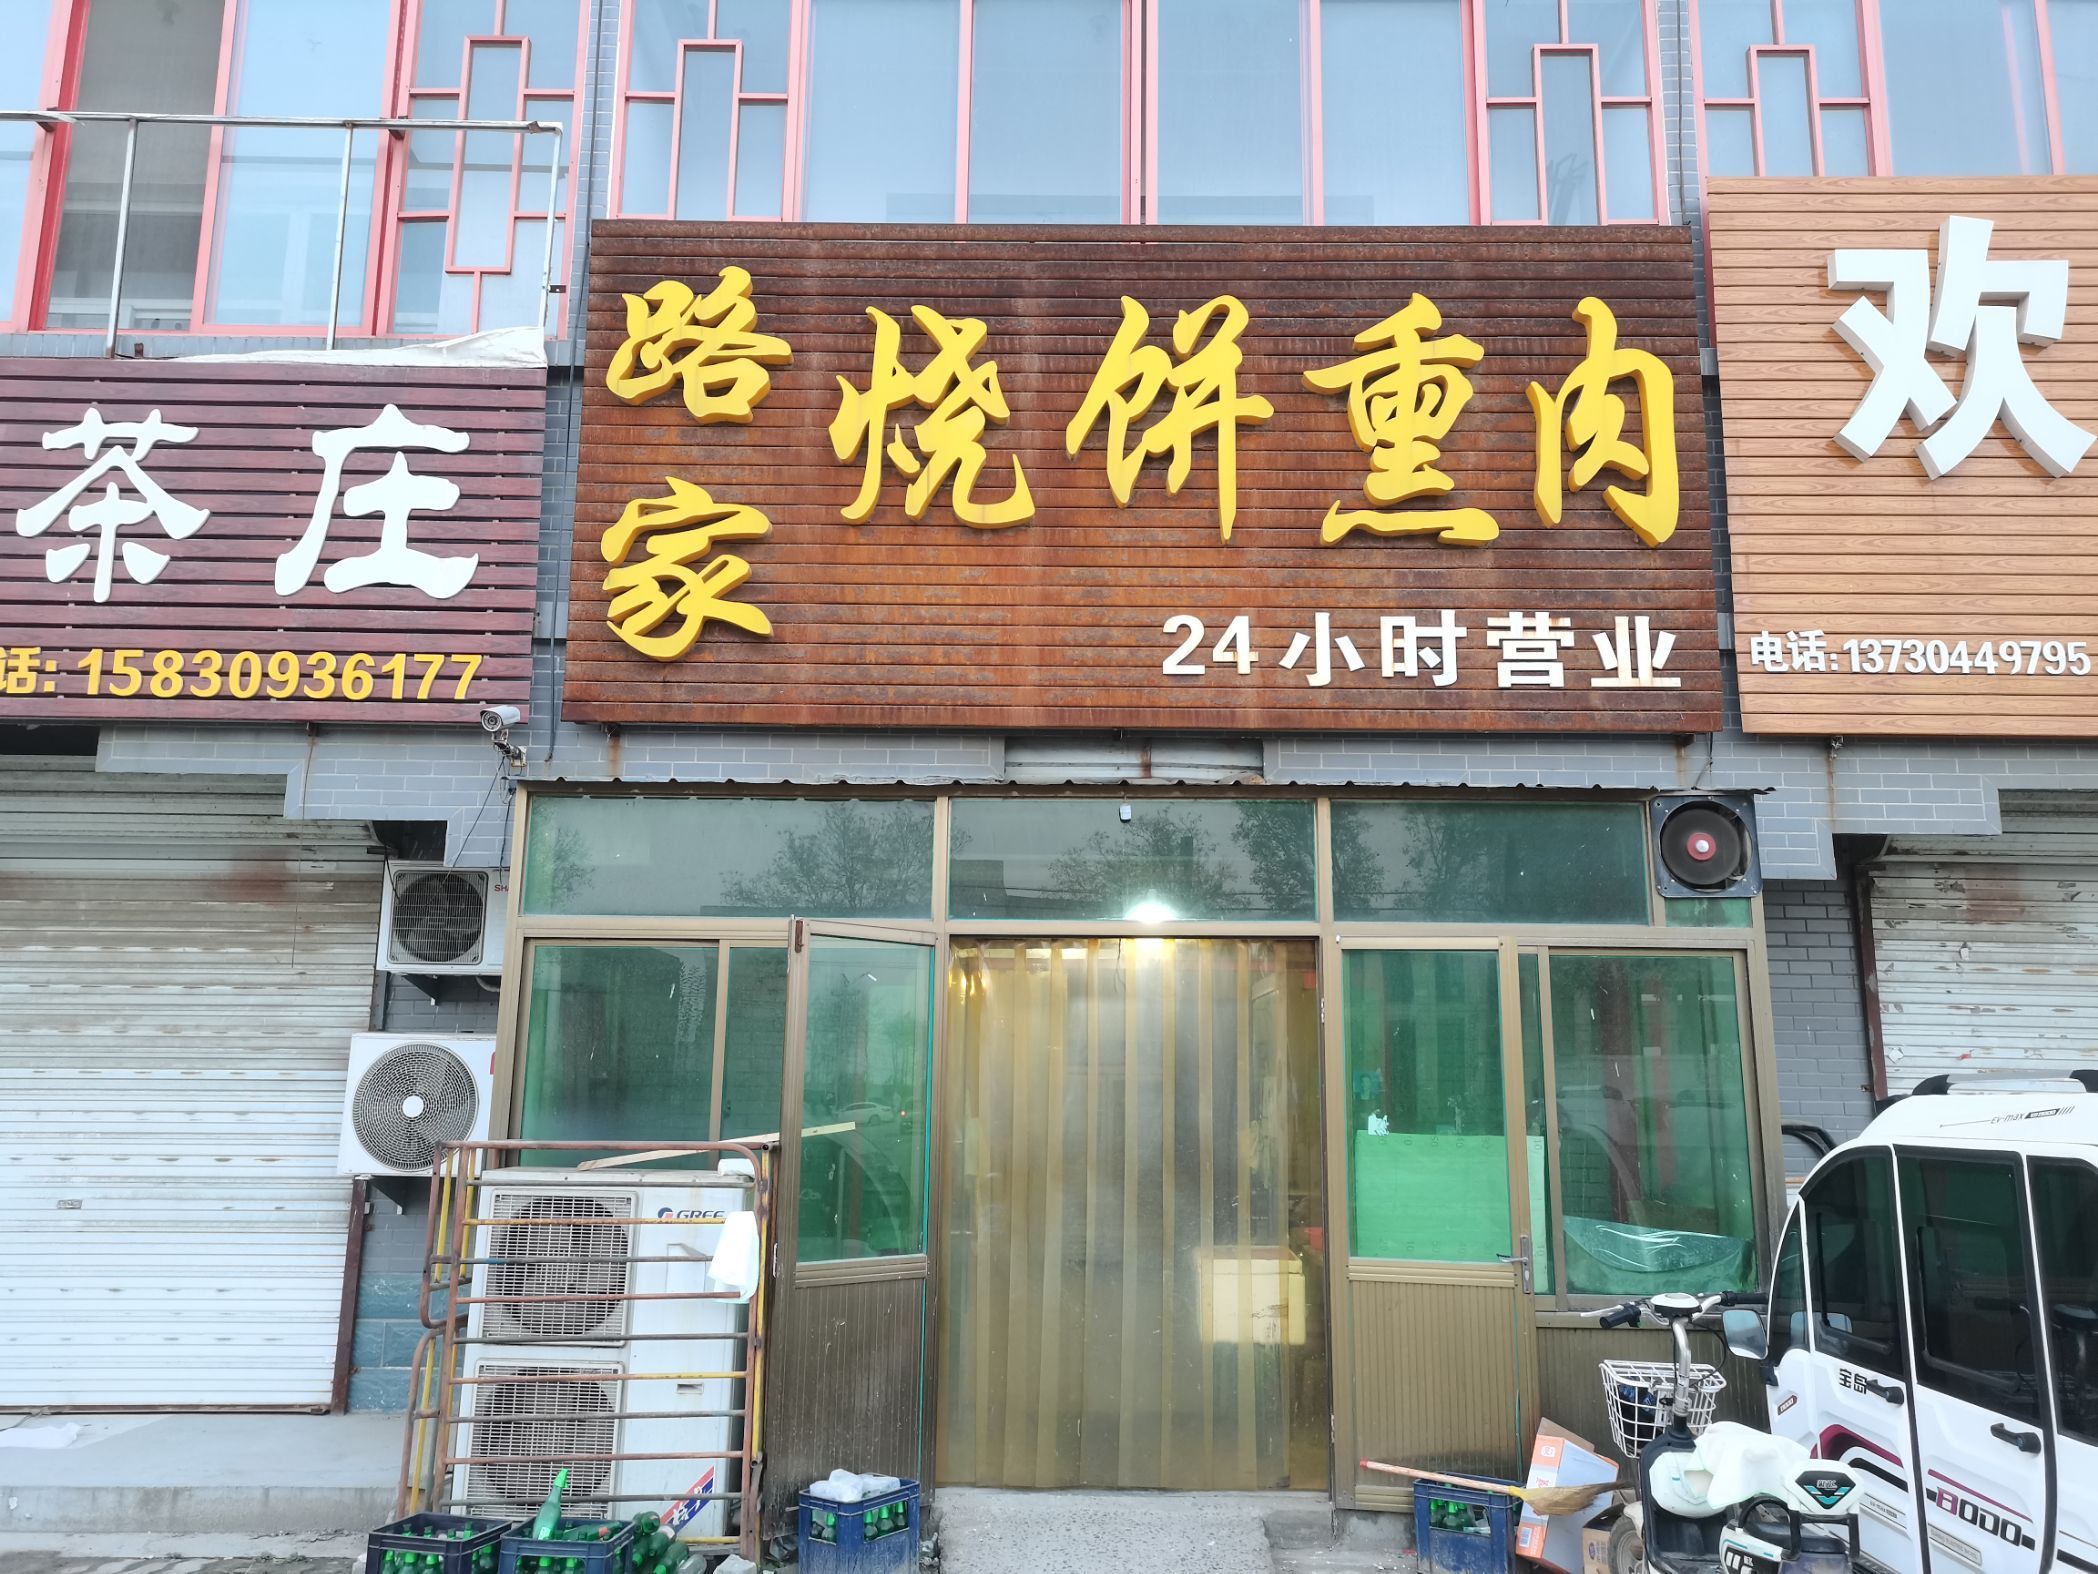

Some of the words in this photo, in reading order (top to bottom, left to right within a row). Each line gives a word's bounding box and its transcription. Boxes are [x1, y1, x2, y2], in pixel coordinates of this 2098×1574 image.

[605, 265, 793, 662] 路家
[1827, 214, 2097, 480] 欢
[15, 403, 479, 603] 茶庄
[1161, 608, 1682, 690] 24小时营业
